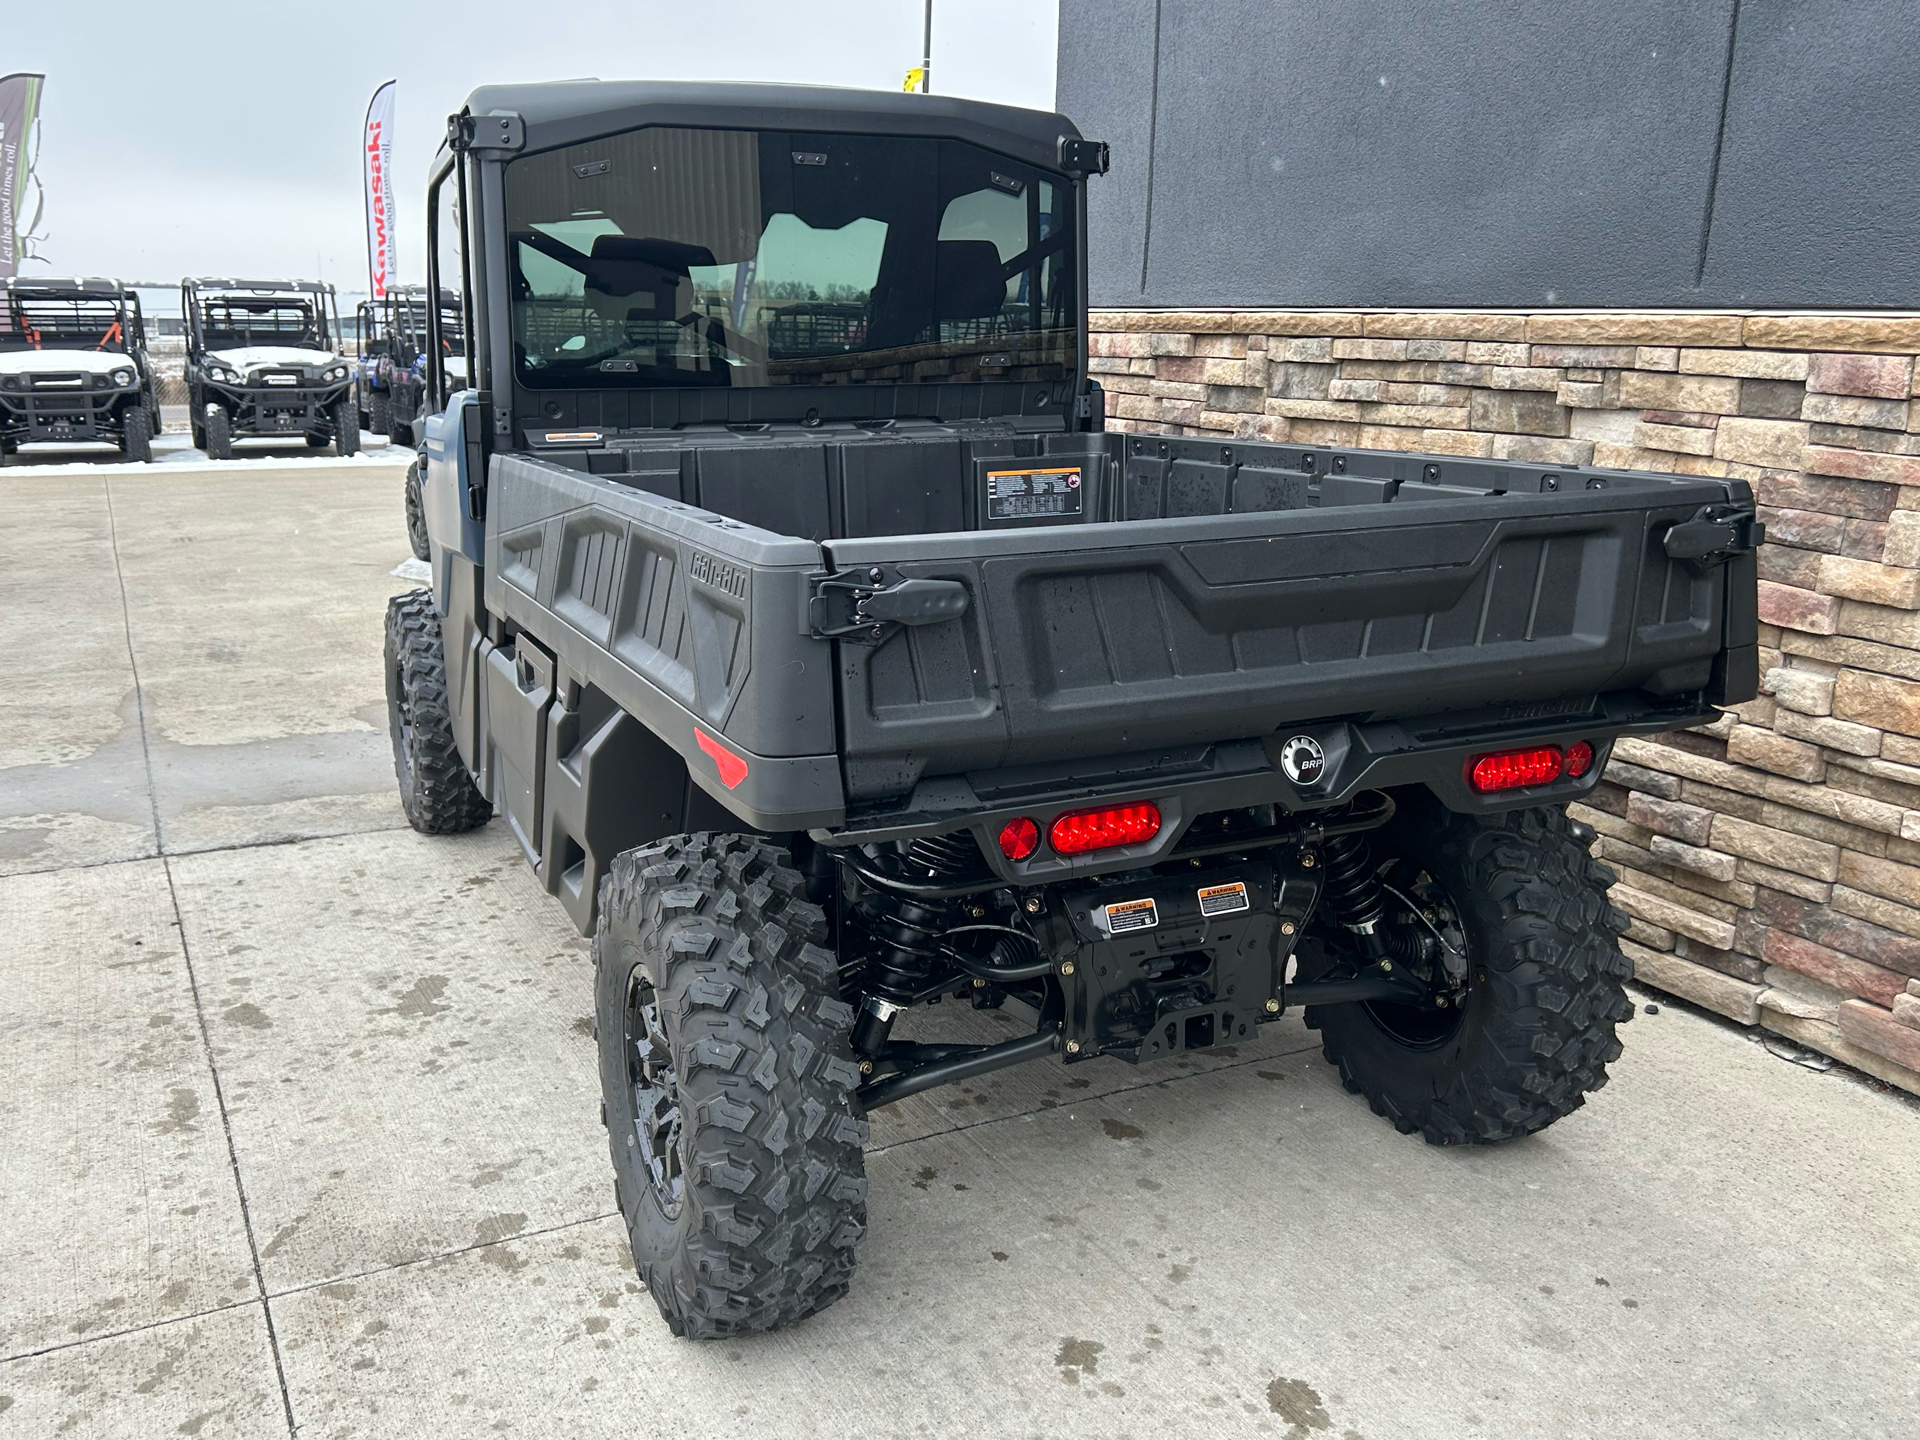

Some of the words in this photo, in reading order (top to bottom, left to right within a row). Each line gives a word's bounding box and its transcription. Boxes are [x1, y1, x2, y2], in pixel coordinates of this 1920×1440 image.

[5, 142, 17, 163] roll.
[2, 166, 13, 196] times
[1, 198, 13, 226] good
[367, 120, 386, 298] Kawasaki
[385, 203, 395, 231] good
[1, 226, 12, 246] the
[0, 247, 12, 264] Let
[1301, 759, 1322, 770] BRP
[1211, 886, 1237, 895] WARNING
[1121, 902, 1147, 911] WARNING
